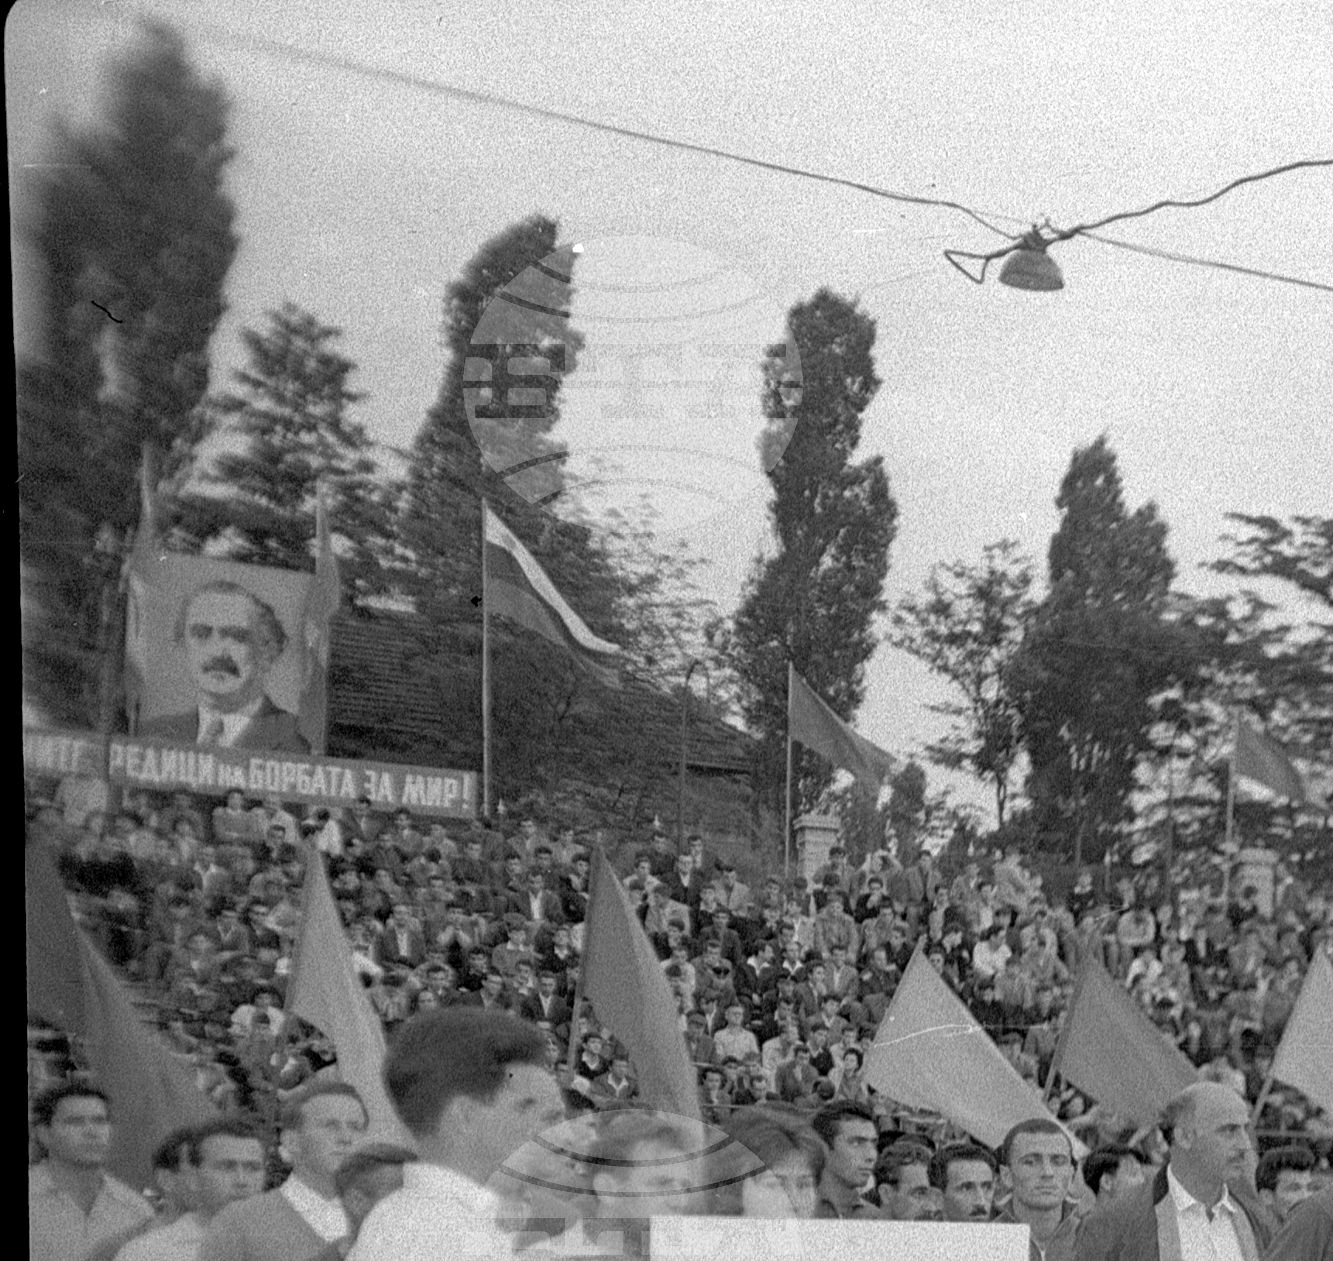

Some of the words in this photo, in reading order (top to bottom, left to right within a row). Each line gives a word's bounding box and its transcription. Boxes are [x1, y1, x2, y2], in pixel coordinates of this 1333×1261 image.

[250, 758, 355, 798] БОРБАТА
[363, 769, 395, 802] ЗА
[402, 772, 470, 809] МИР!
